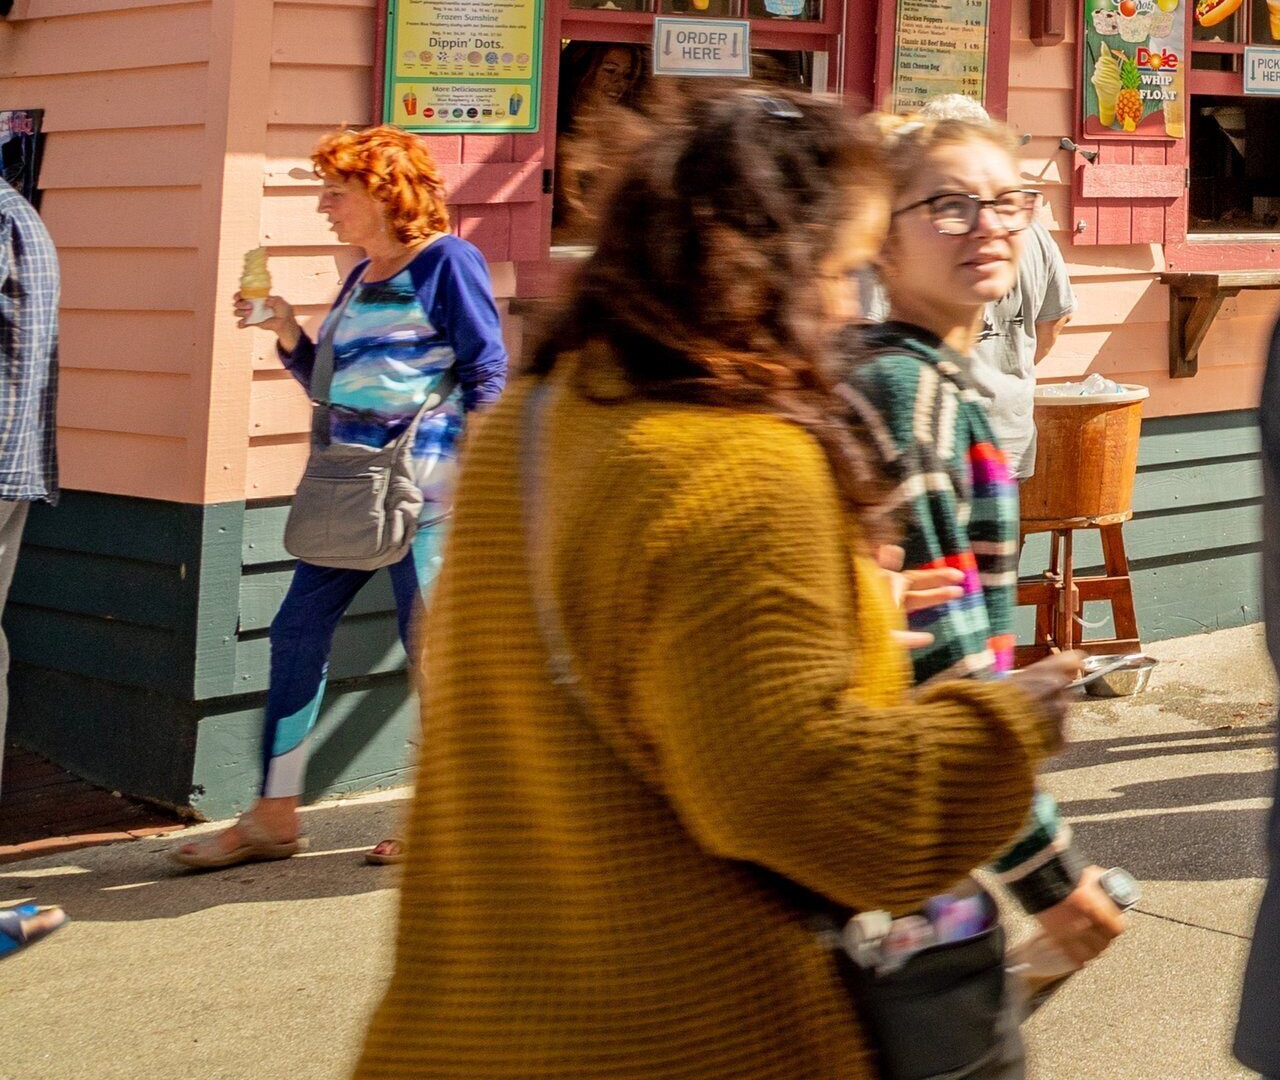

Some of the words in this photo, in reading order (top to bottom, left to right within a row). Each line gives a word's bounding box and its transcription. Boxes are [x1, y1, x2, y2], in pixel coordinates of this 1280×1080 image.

[429, 38, 471, 49] Dippin'
[475, 39, 504, 49] Dots.
[676, 31, 728, 45] ORDER
[682, 47, 721, 60] HERE
[1136, 48, 1178, 68] Dole
[1141, 74, 1173, 85] WHIP
[1139, 89, 1176, 100] FLOAT
